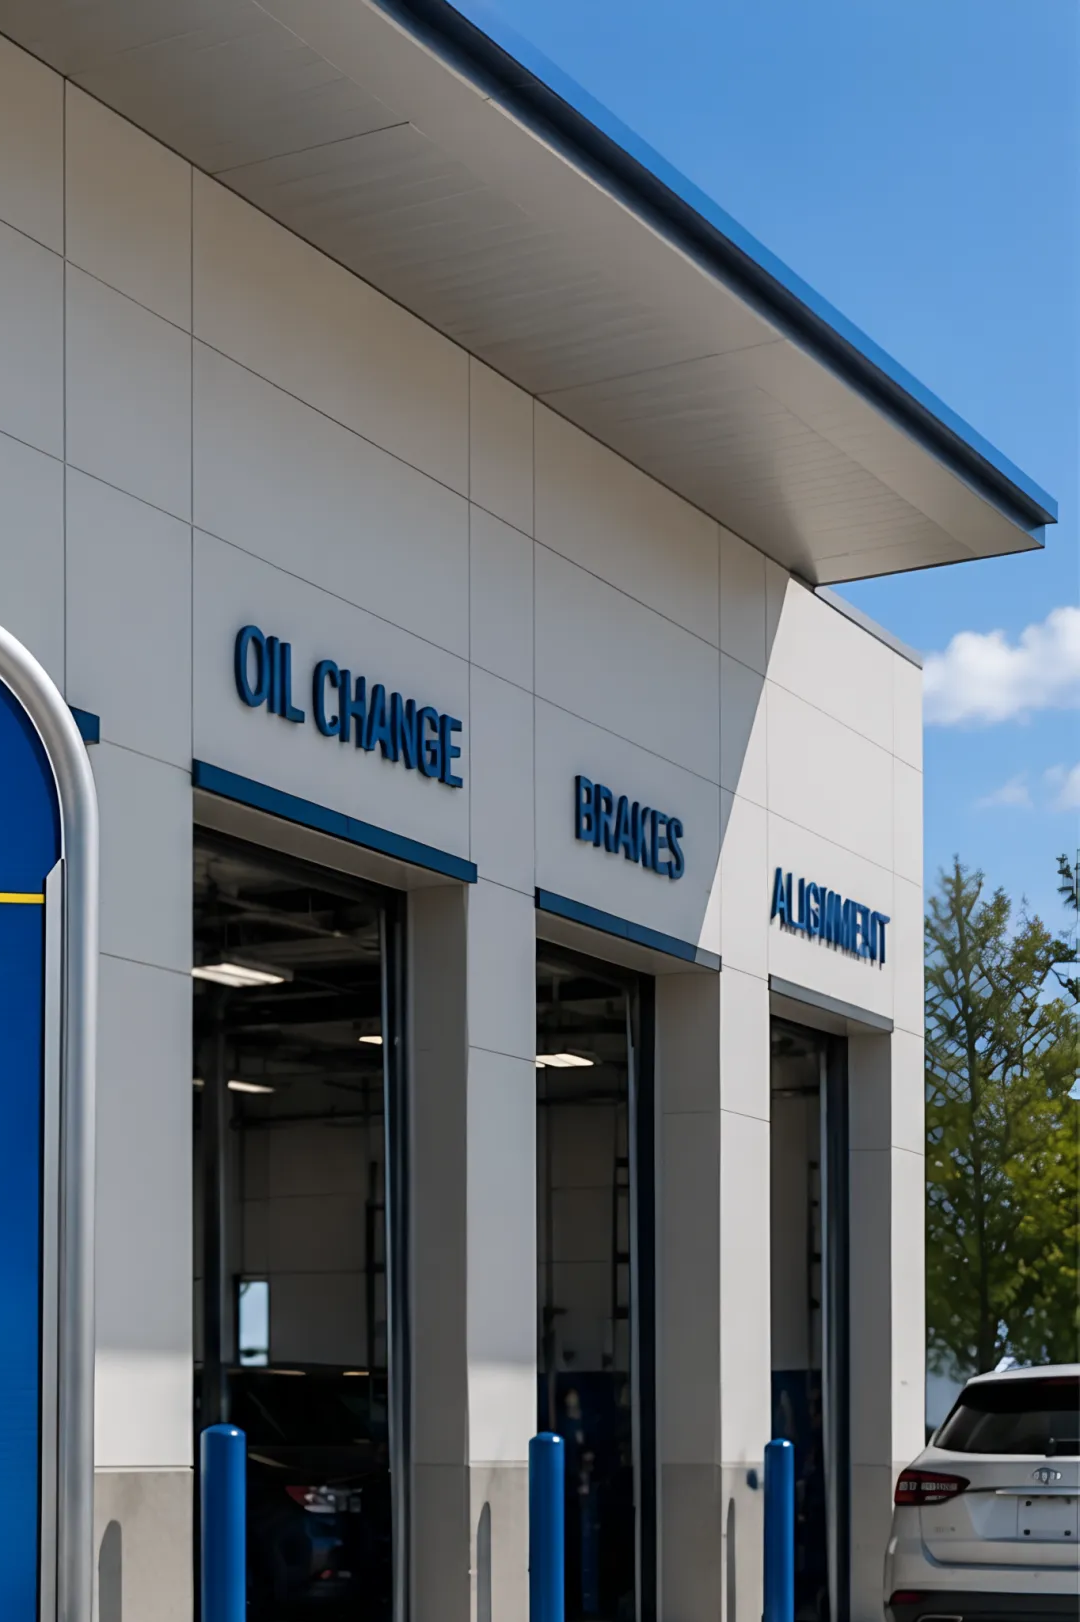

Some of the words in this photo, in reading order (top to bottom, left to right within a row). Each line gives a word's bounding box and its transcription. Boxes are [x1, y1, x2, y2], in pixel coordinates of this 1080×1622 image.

[234, 625, 305, 723] OIL
[313, 660, 463, 788] CHANGE
[575, 775, 685, 880] BRAKES
